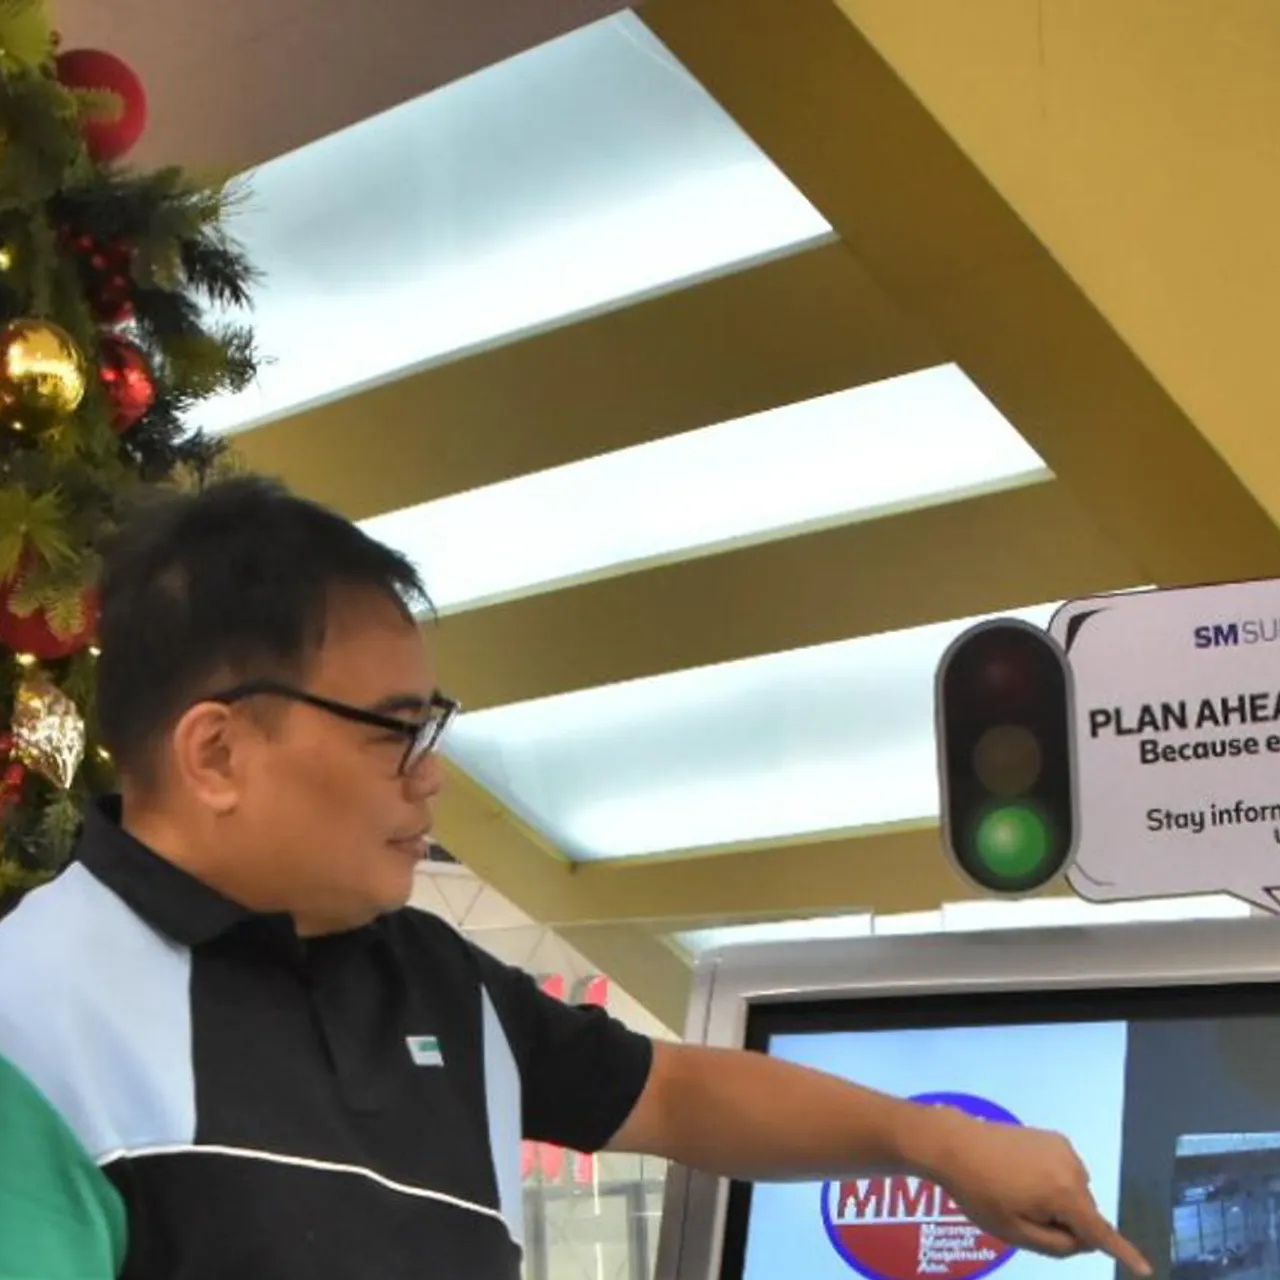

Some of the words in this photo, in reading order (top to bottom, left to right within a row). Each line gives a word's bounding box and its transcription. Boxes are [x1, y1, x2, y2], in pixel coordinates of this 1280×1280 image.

[1088, 701, 1188, 738] PLAN
[1140, 737, 1259, 764] Because
[1146, 808, 1205, 834] Stay
